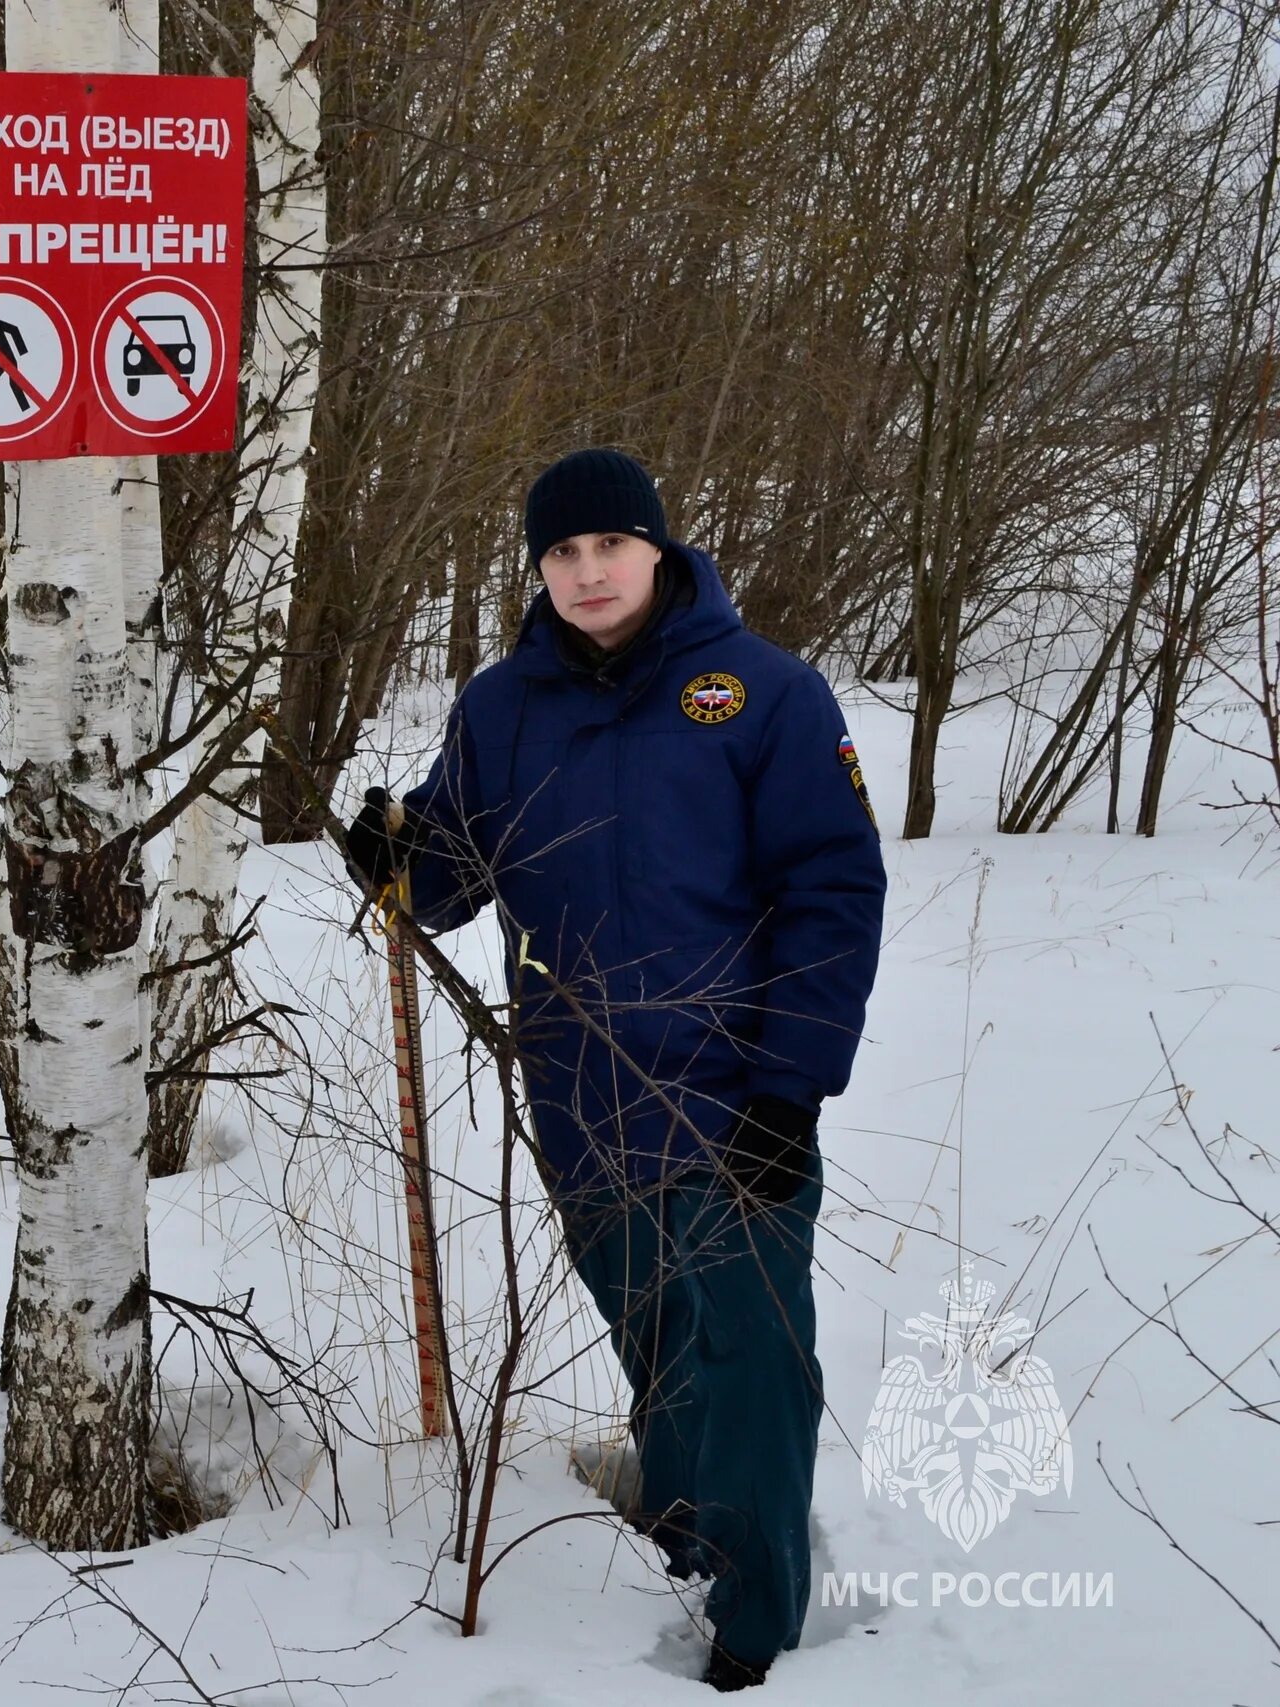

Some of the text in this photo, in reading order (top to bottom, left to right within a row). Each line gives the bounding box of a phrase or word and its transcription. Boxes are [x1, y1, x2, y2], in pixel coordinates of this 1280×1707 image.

[80, 115, 231, 159] (ВЫЕЗД)
[13, 157, 152, 203] НА ЛЁД
[683, 698, 740, 721] EMERCOM
